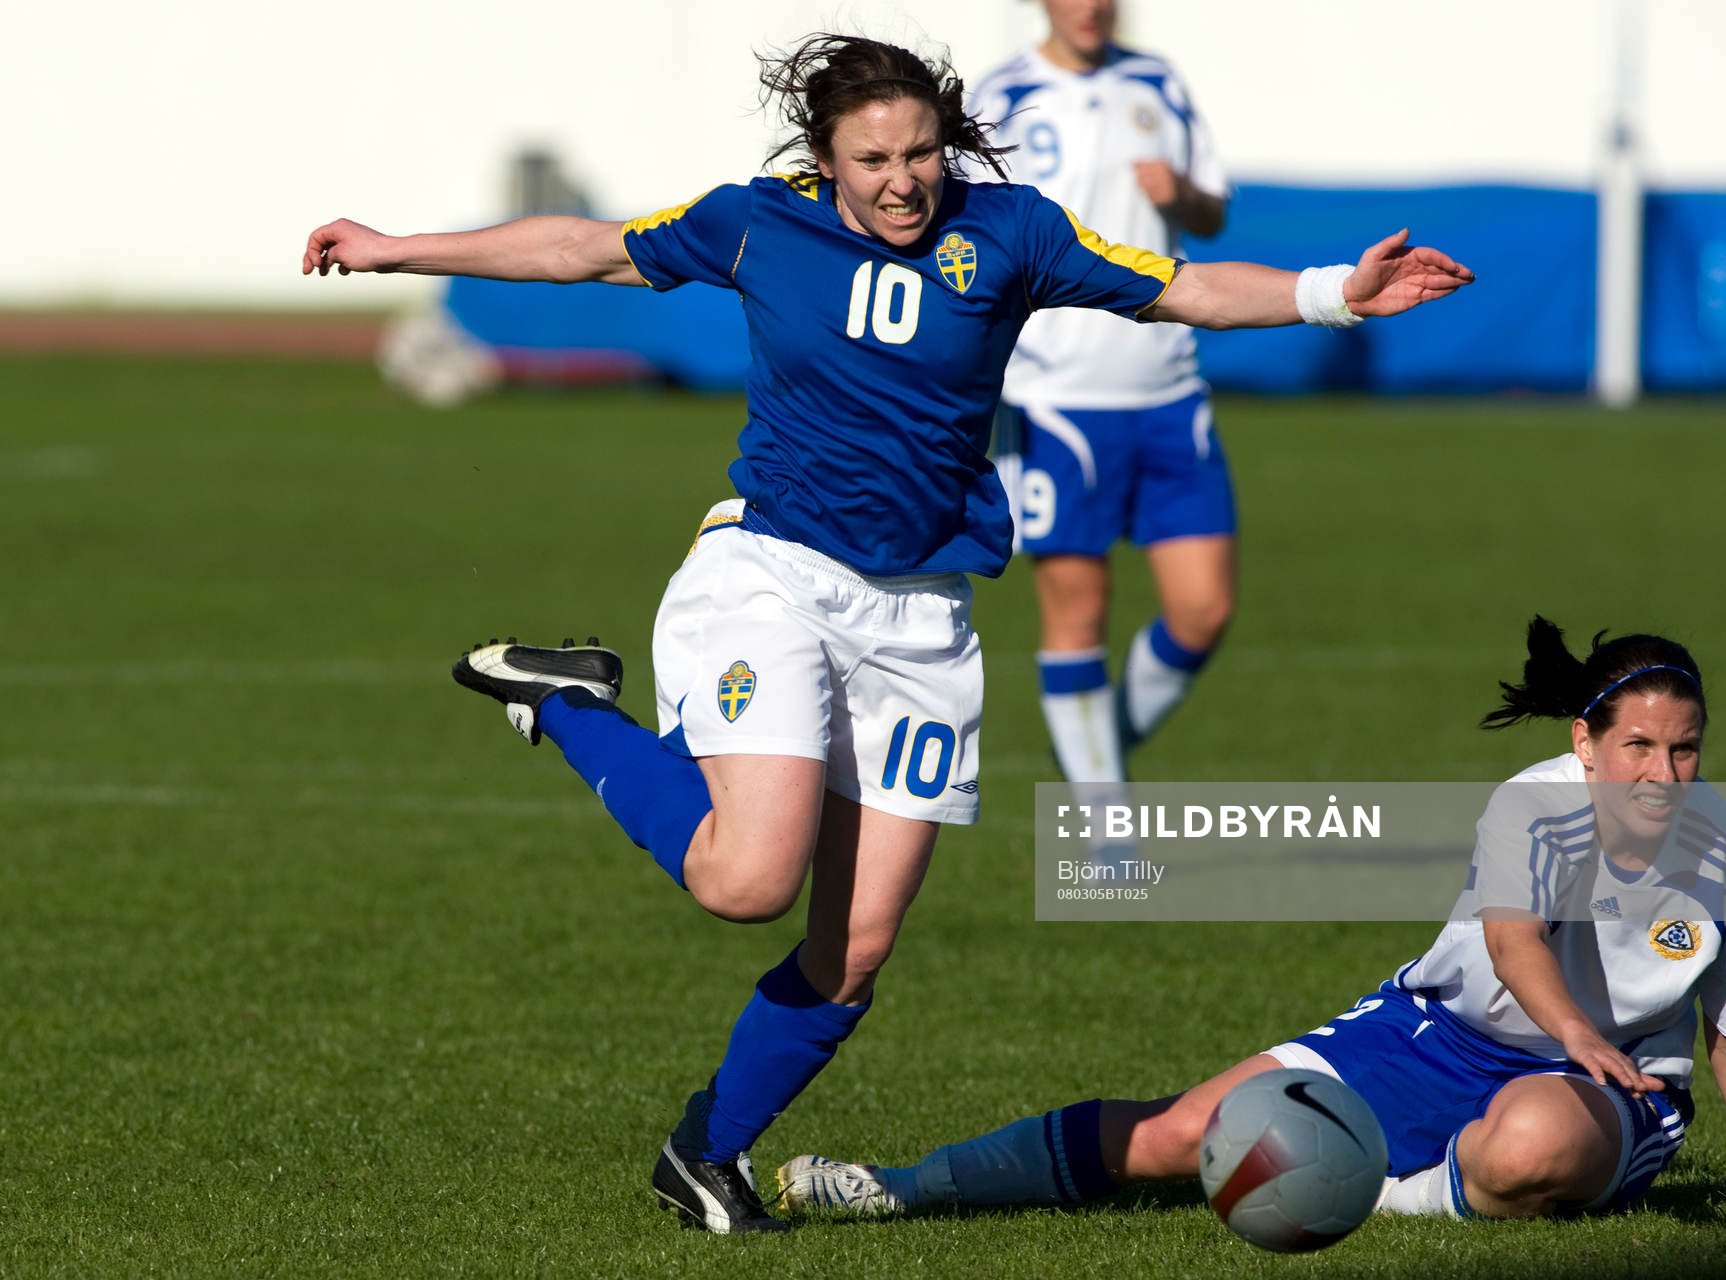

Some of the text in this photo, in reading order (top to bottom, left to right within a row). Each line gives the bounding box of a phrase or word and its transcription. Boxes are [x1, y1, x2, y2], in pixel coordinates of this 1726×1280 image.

[1026, 121, 1062, 180] 9
[846, 260, 923, 345] 10
[1021, 468, 1057, 539] 9
[880, 715, 957, 800] 10
[1590, 902, 1623, 919] adidas
